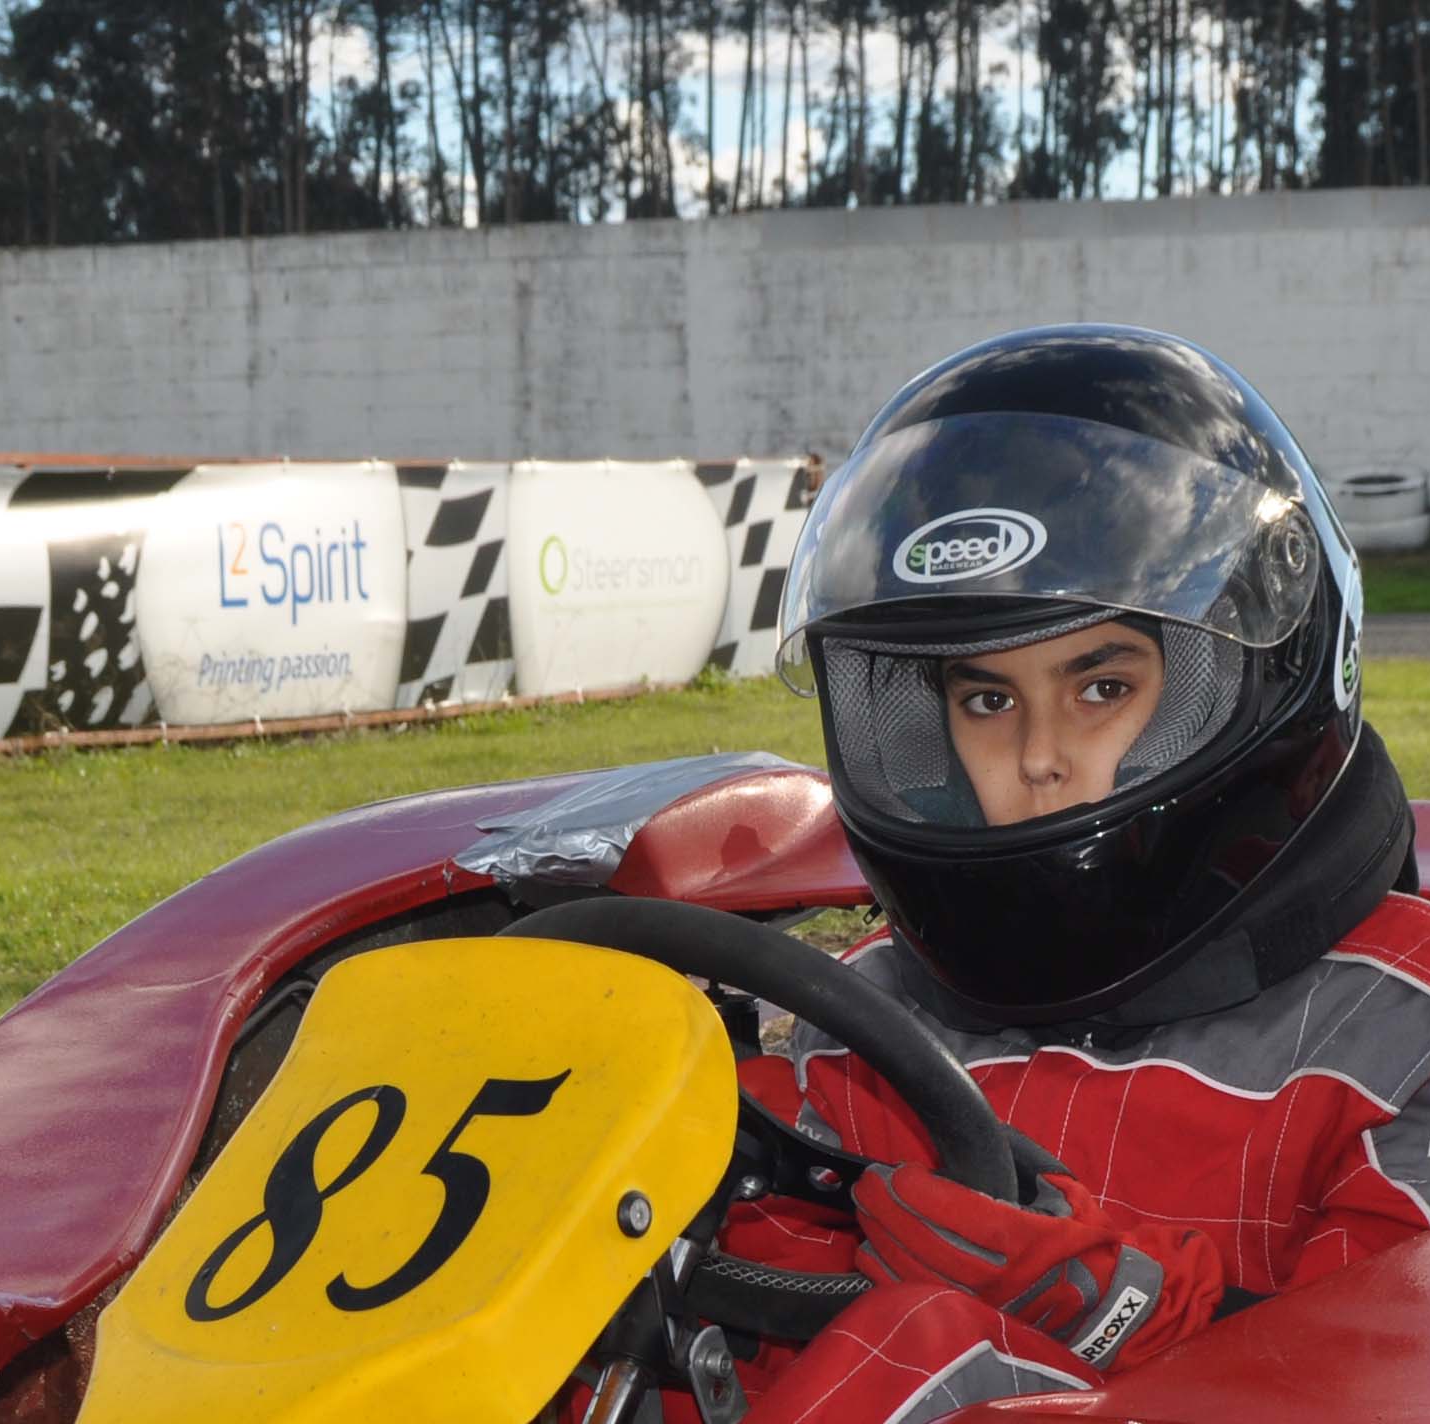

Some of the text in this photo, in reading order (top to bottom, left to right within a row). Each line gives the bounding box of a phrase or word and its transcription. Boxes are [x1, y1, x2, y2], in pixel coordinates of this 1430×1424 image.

[258, 519, 369, 627] Spirit
[909, 525, 1005, 576] speed
[197, 650, 276, 694] Printing
[184, 1068, 572, 1322] 85
